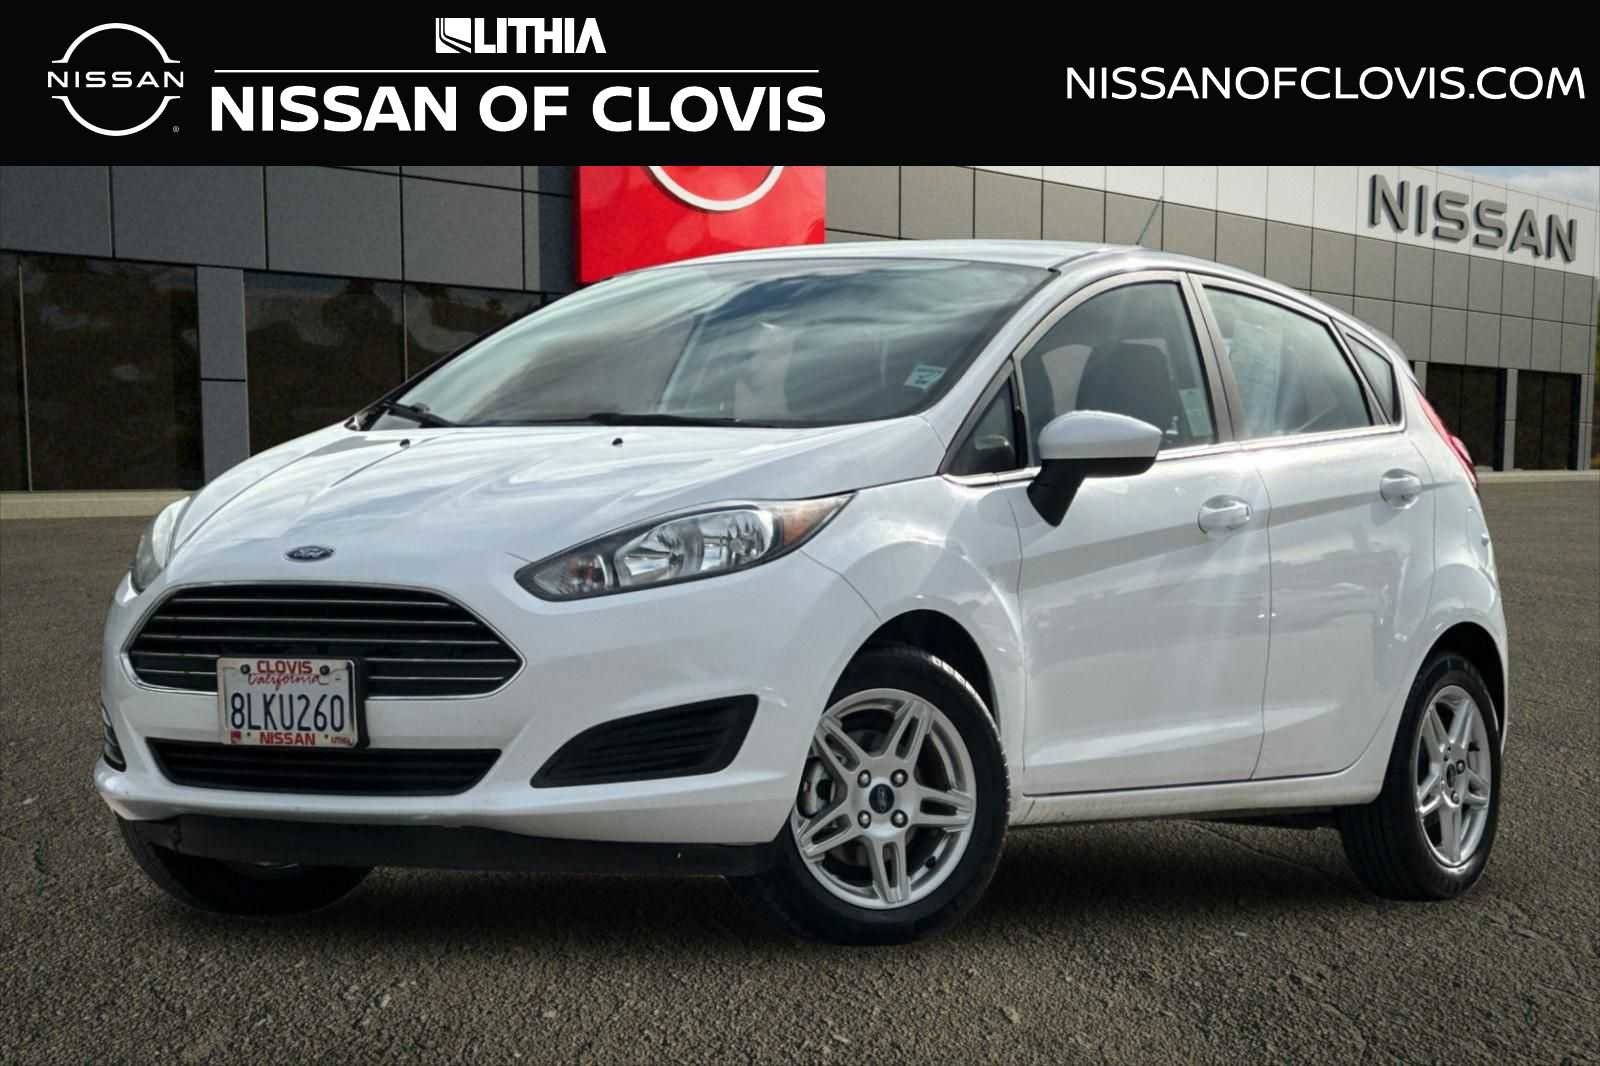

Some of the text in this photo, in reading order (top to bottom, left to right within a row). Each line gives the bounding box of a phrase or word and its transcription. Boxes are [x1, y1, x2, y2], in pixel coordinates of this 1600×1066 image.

[1368, 173, 1578, 263] NISSAN
[256, 660, 313, 674] CLOVIS
[230, 692, 345, 732] 8LKU260
[259, 731, 316, 745] NISSAN
